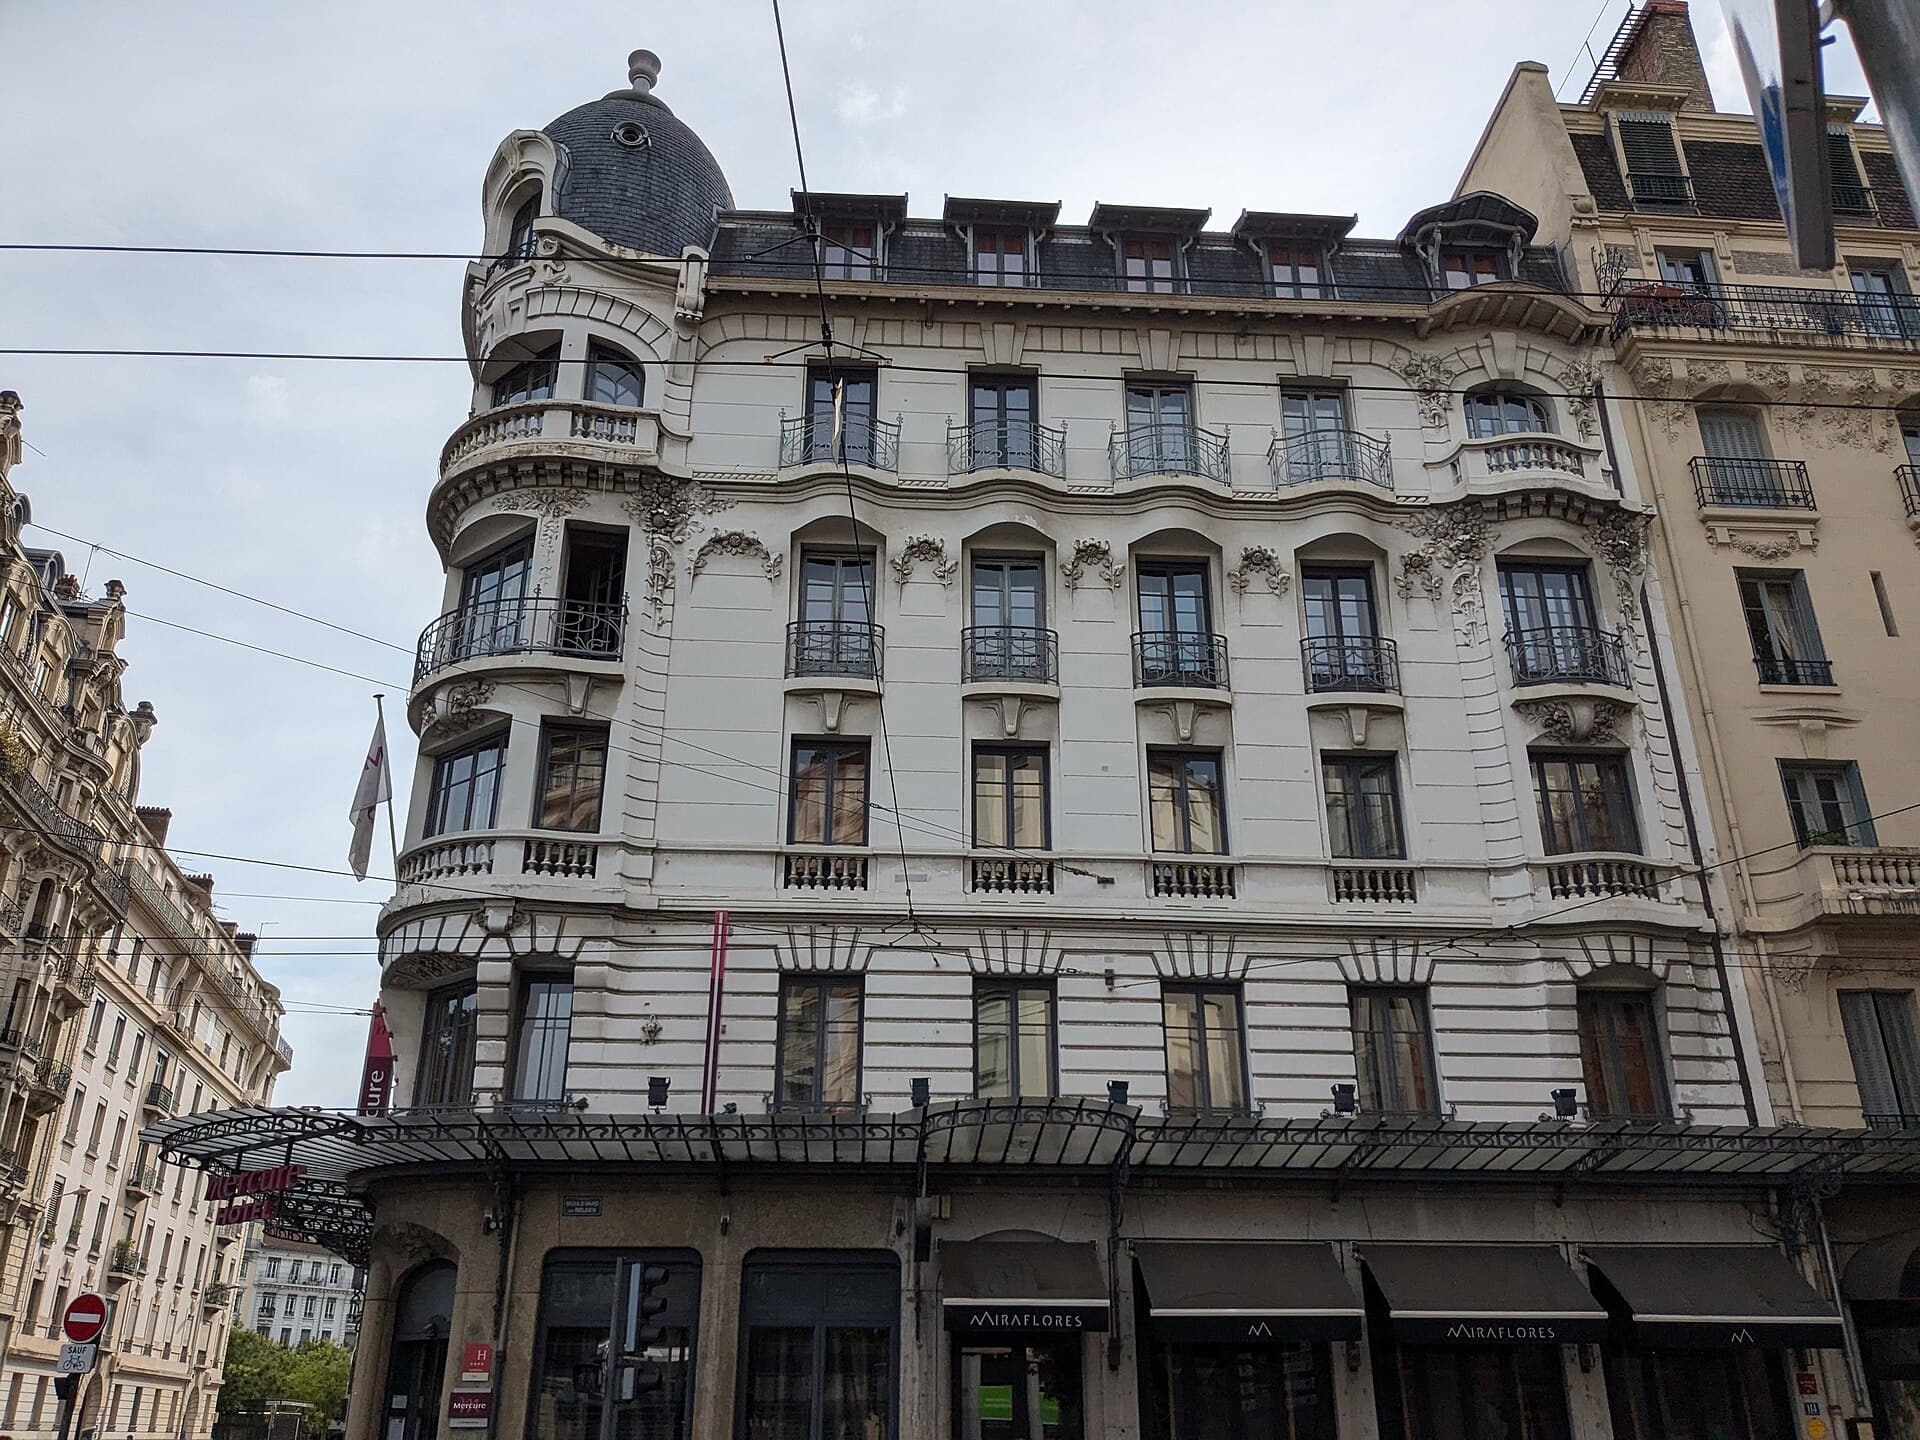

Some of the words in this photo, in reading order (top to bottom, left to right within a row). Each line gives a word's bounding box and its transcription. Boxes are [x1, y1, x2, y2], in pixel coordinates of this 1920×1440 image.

[215, 1201, 273, 1225] HOTEL
[969, 1311, 1083, 1327] MIRAFLORES
[1447, 1323, 1556, 1339] MIRAFLORES
[67, 1346, 88, 1354] SAUF
[477, 1349, 487, 1360] H
